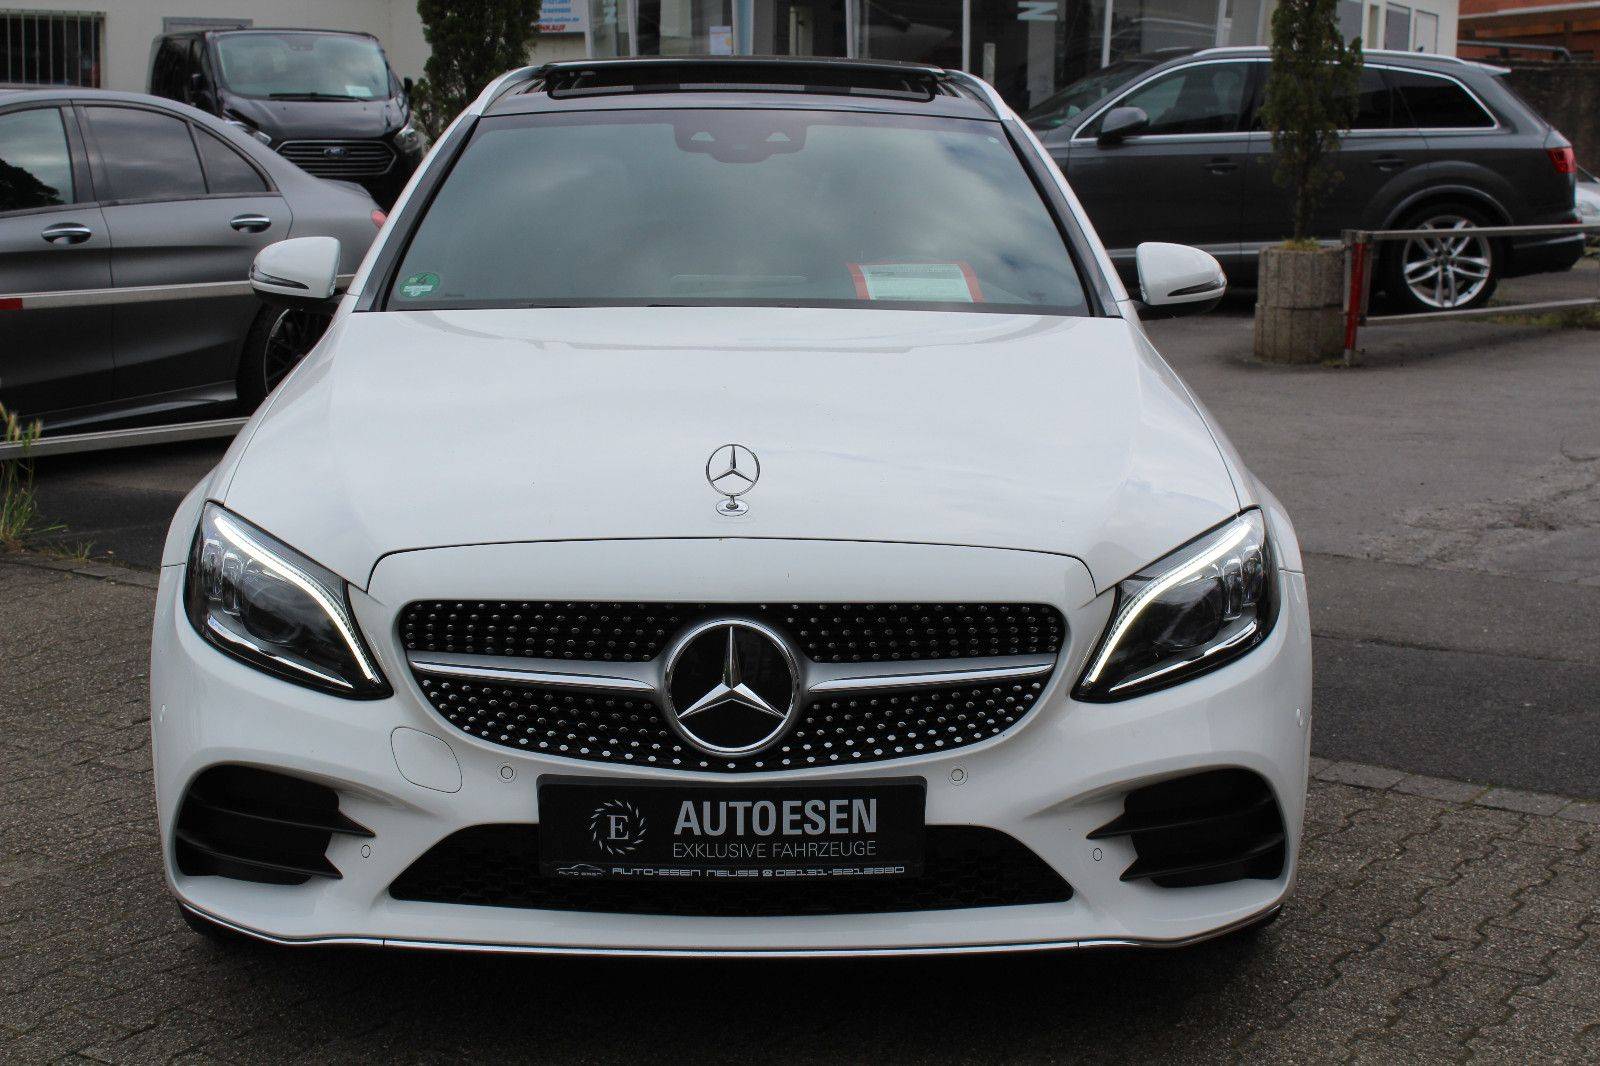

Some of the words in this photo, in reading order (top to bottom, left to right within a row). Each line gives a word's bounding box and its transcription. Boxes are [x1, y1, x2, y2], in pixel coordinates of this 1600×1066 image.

[606, 814, 629, 840] E
[673, 799, 877, 836] AUTOESEN
[673, 842, 767, 858] EXKLUSIVE
[772, 840, 877, 858] FAHRZEUGE
